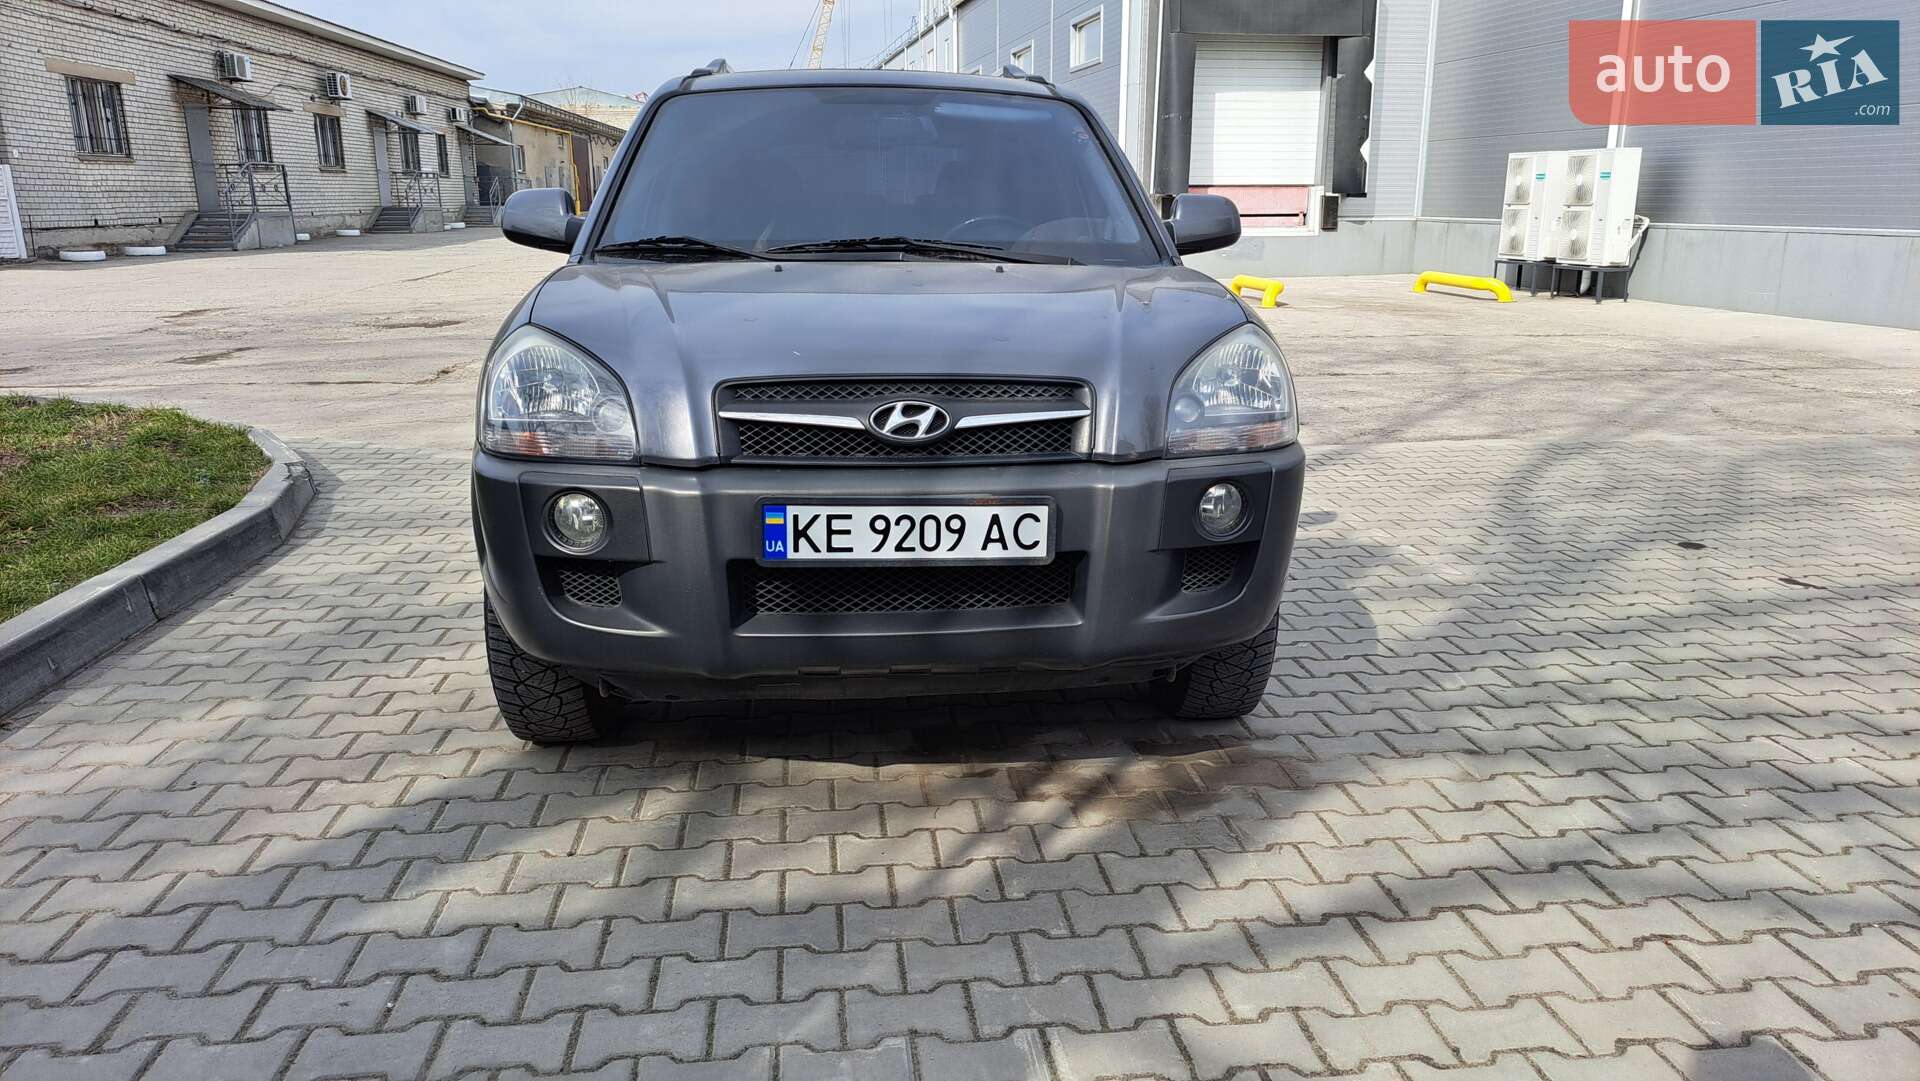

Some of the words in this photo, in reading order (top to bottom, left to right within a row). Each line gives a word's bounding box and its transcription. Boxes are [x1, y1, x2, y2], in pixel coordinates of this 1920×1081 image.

[792, 513, 854, 553] KE
[868, 513, 967, 553] 9209
[980, 512, 1041, 551] AC
[765, 540, 784, 553] UA
